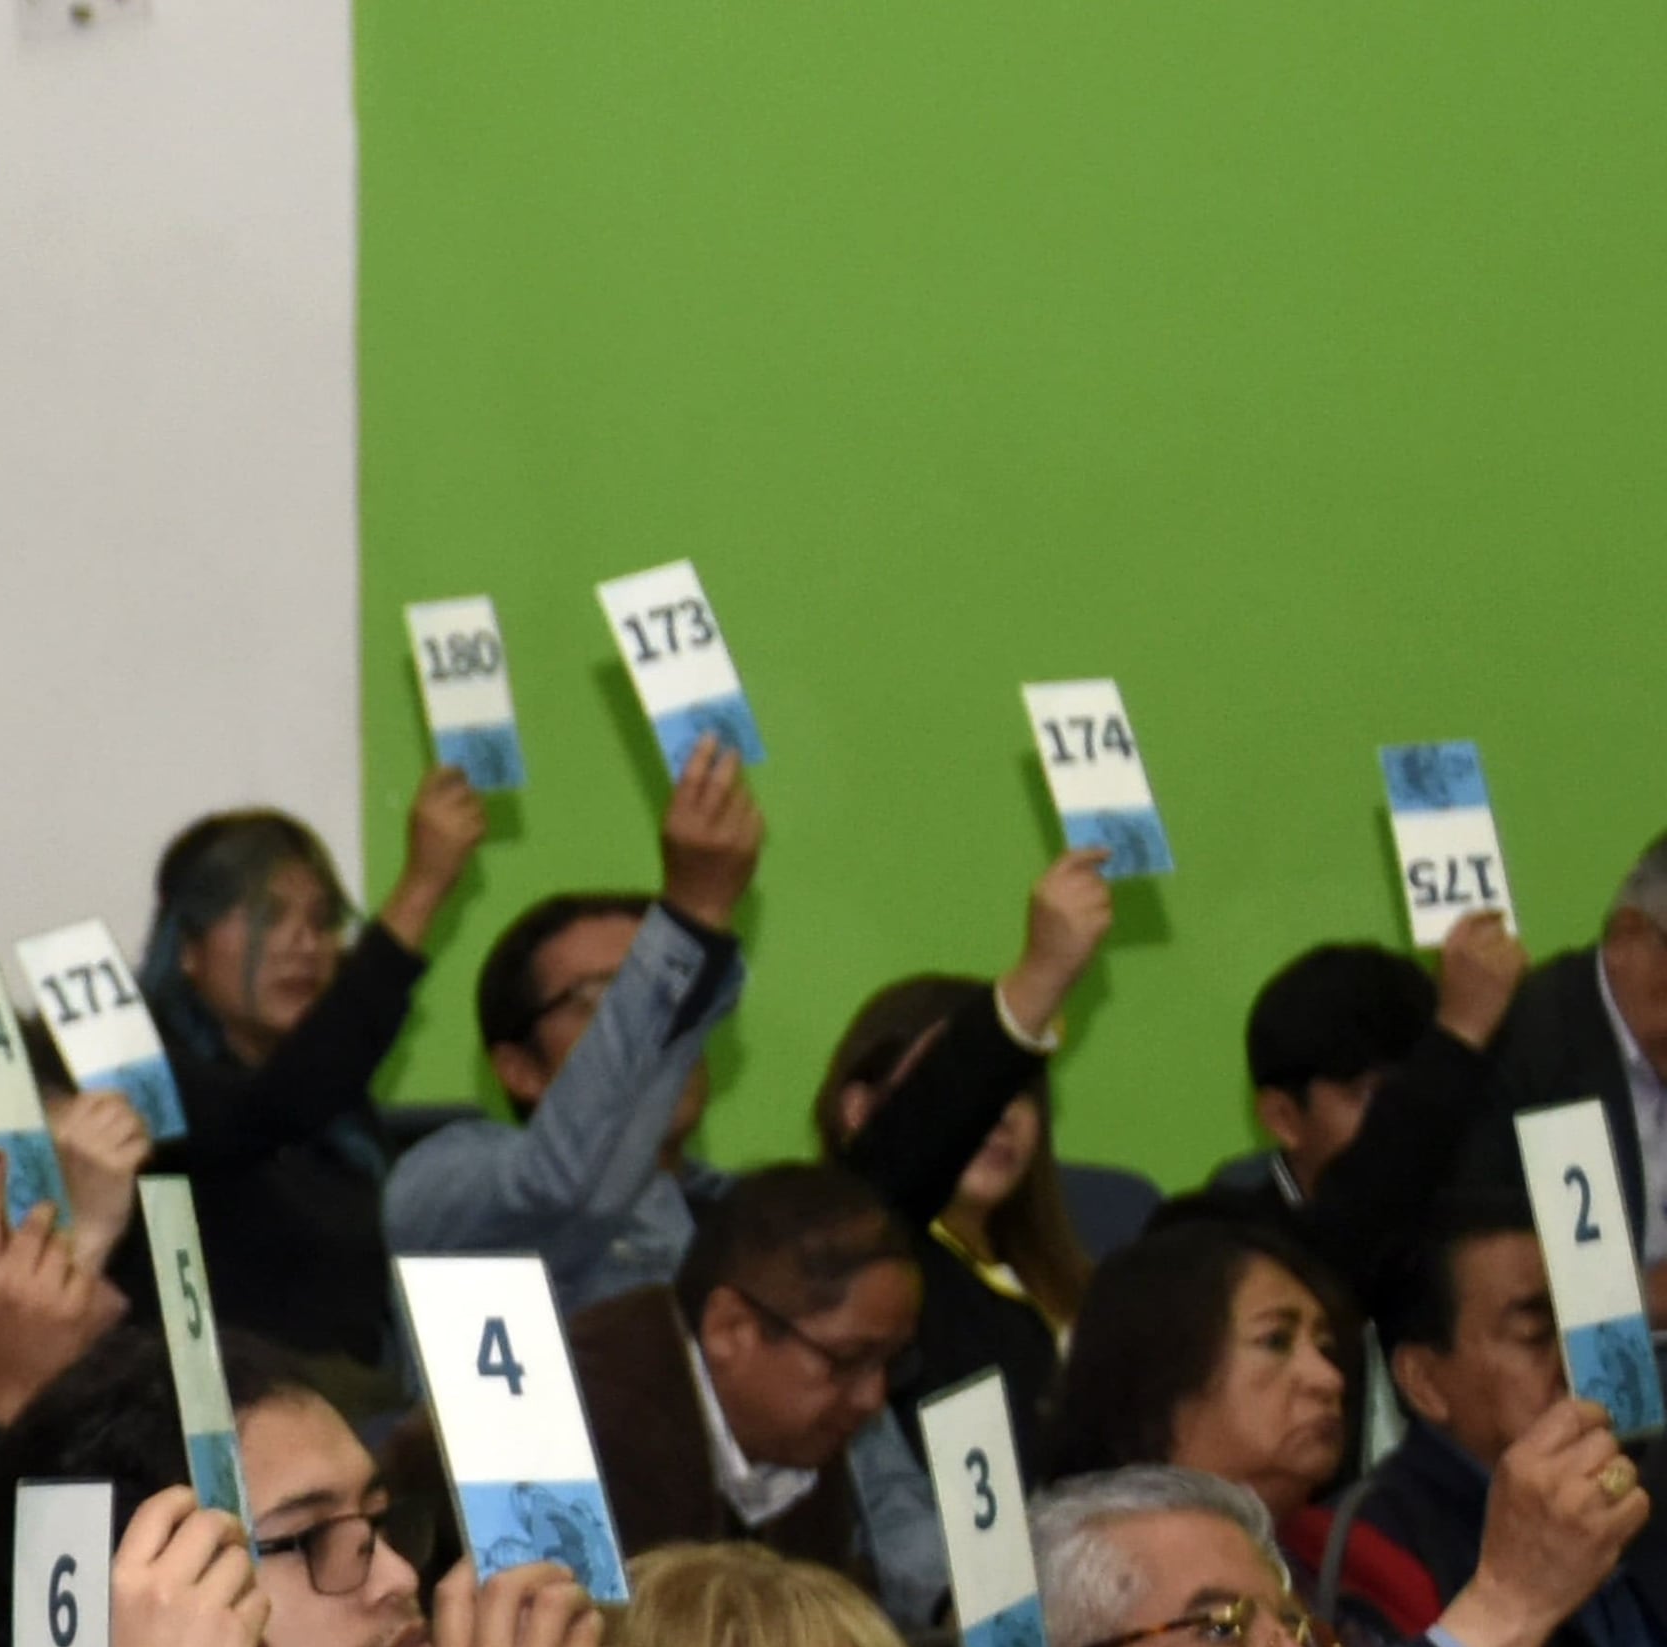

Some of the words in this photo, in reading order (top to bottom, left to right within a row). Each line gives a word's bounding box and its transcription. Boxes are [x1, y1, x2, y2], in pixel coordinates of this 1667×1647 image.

[424, 630, 501, 683] 180
[623, 597, 716, 663] 173
[1043, 715, 1135, 766] 174
[1408, 854, 1496, 907] 175
[40, 961, 139, 1024] 171
[1563, 1164, 1601, 1243] 2
[175, 1248, 205, 1341] 5
[475, 1316, 525, 1396] 4
[965, 1447, 998, 1531] 3
